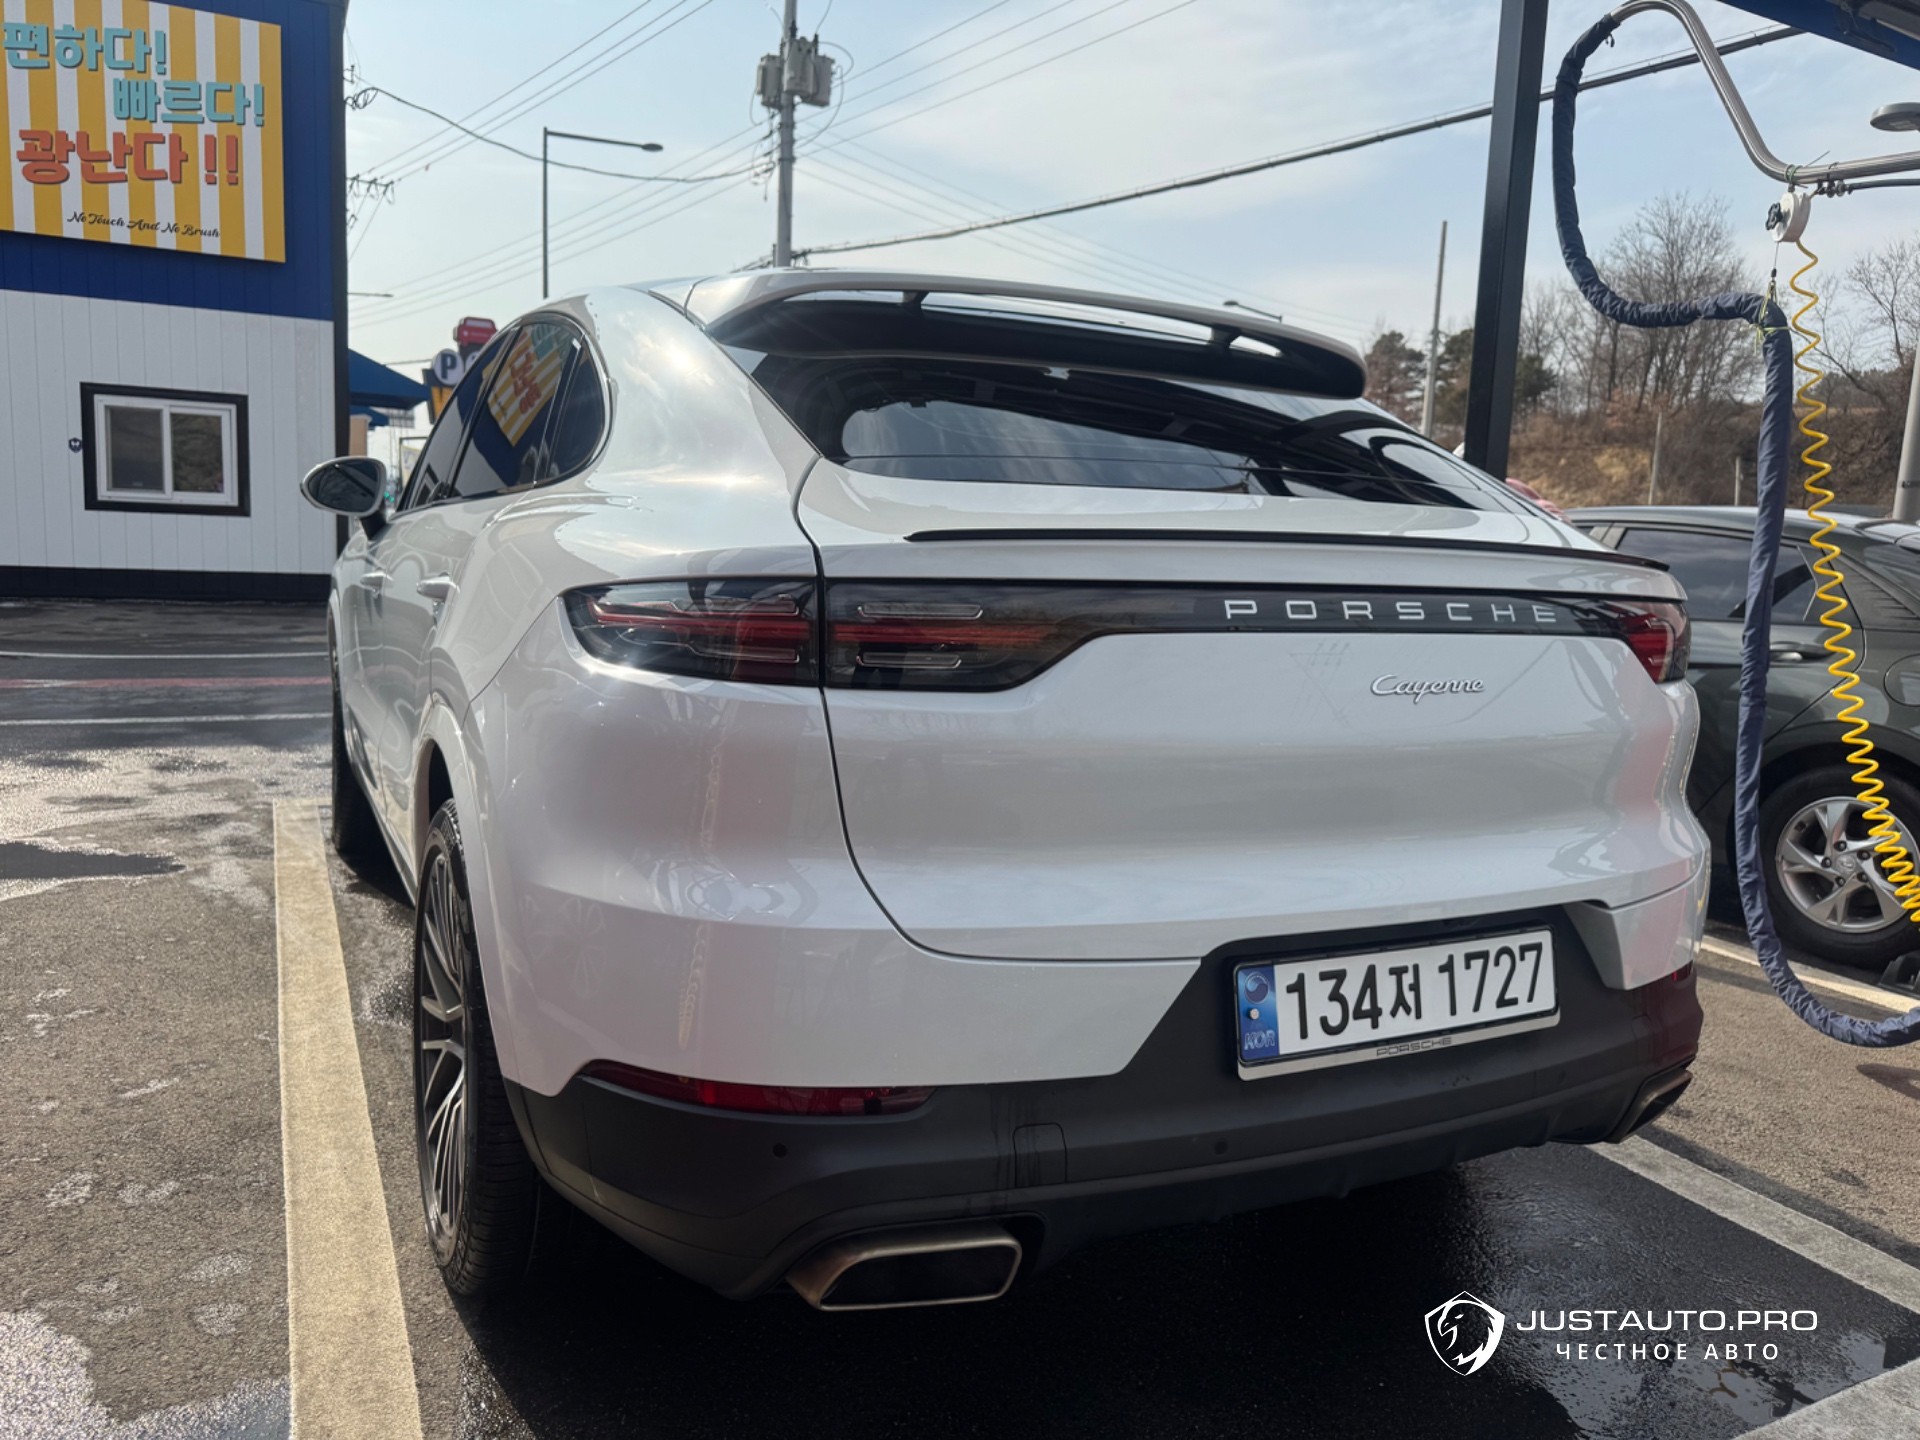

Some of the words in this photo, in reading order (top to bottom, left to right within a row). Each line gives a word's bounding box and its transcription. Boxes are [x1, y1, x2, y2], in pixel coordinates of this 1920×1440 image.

[3, 22, 167, 75] 편하다!
[113, 78, 265, 127] 빠르다!
[16, 129, 188, 185] 광난다
[66, 211, 86, 223] No
[88, 213, 125, 227] Touch
[126, 219, 160, 231] And
[160, 222, 180, 233] No
[181, 224, 220, 238] Brush
[441, 352, 457, 380] P
[1224, 600, 1557, 623] PORSCHE
[1371, 674, 1485, 704] Cayenne
[1286, 963, 1422, 1040] 134저
[1437, 941, 1544, 1017] 1727
[1244, 1029, 1276, 1050] KOR
[1376, 1036, 1452, 1057] PORSCHE
